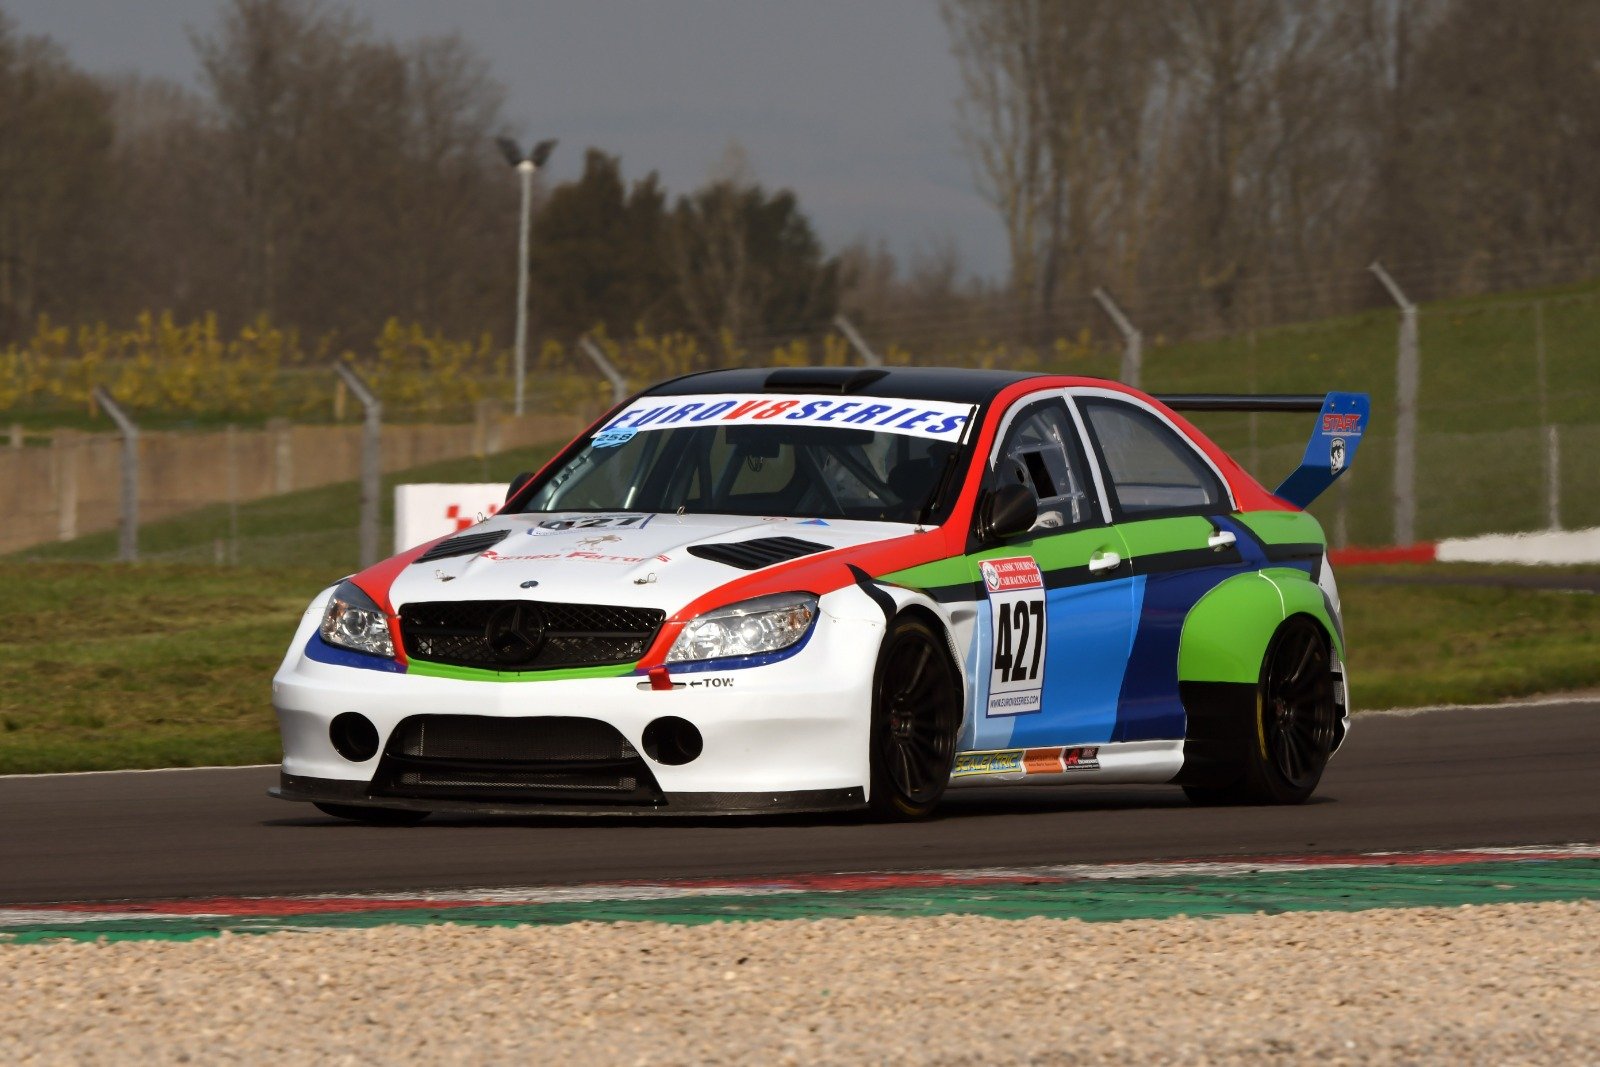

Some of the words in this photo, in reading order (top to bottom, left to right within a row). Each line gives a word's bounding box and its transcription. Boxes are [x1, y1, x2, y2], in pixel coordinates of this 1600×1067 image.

[604, 402, 969, 434] EUROV8SERIES
[1323, 414, 1360, 431] START
[538, 517, 644, 530] 427
[995, 564, 1014, 573] CLASSIC
[1016, 562, 1036, 571] TOURING
[1000, 577, 1010, 586] CAR
[1010, 575, 1028, 585] RACING
[1028, 574, 1040, 583] CLUB
[995, 600, 1044, 683] 427
[703, 678, 734, 687] TOW
